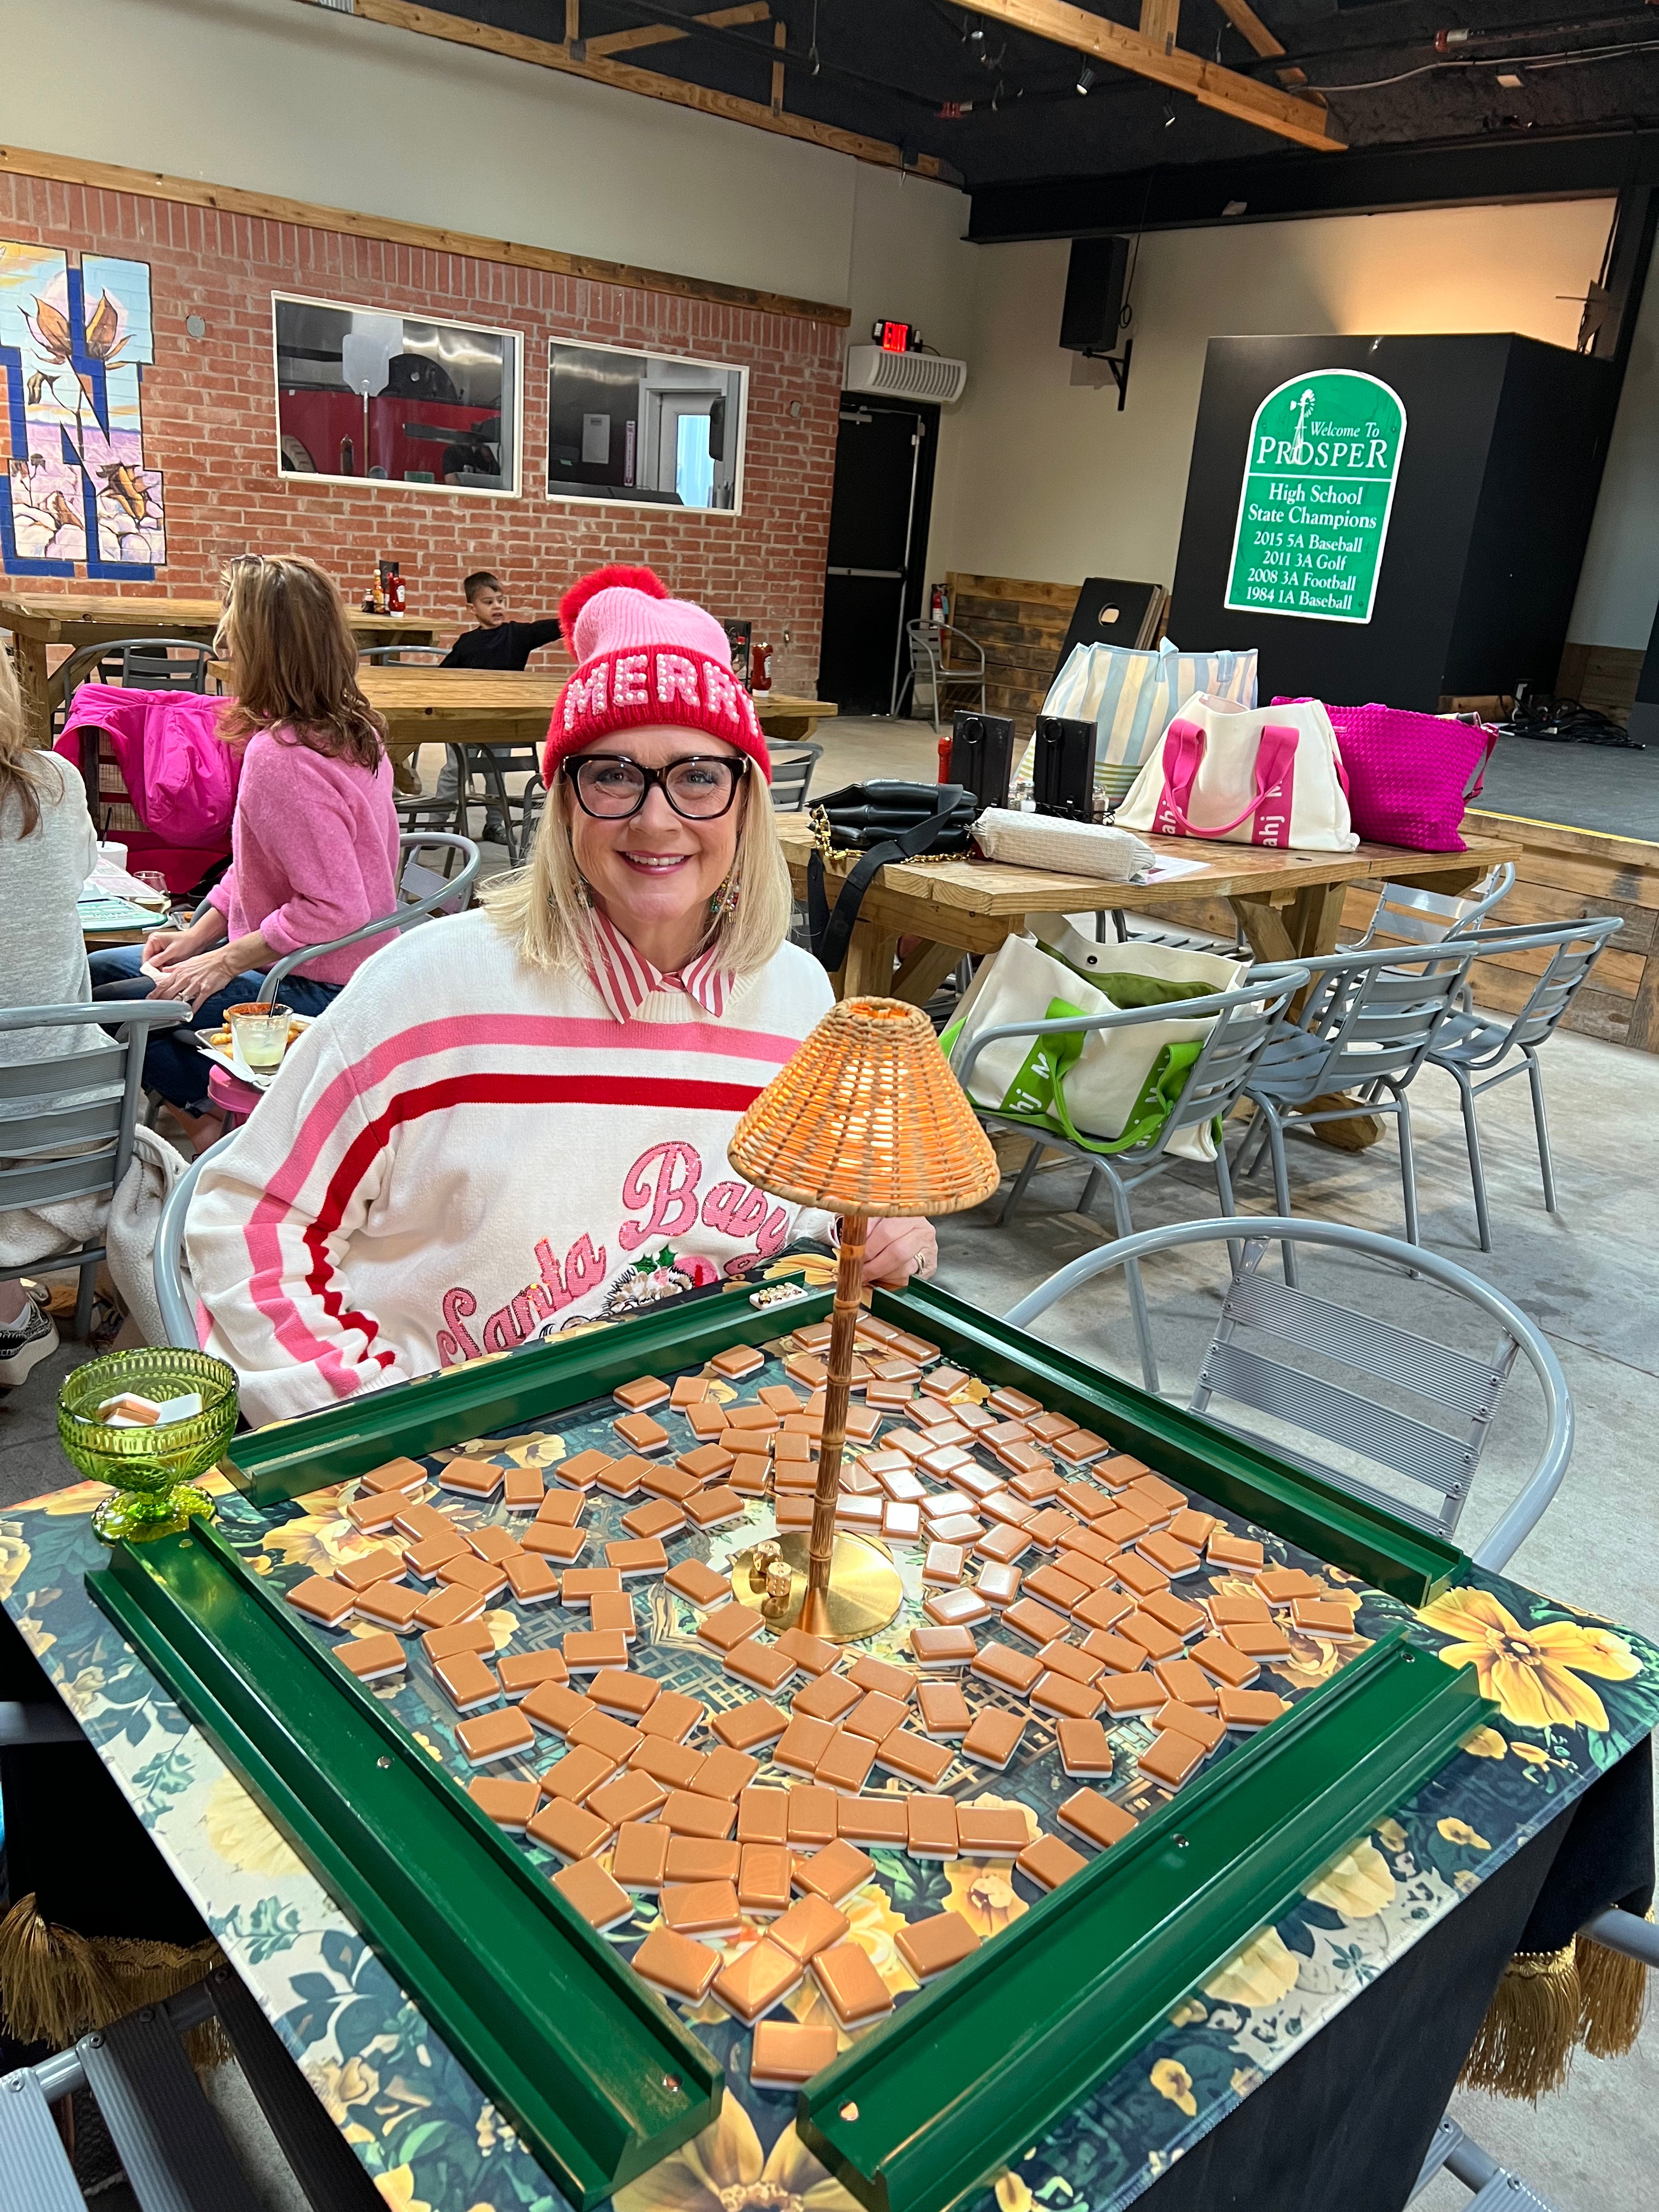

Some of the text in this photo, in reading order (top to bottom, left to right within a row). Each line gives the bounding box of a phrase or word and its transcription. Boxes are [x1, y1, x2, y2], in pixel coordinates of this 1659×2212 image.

[1311, 421, 1380, 438] Welcome To
[1256, 436, 1387, 468] PROSPER
[1268, 482, 1363, 505] High School
[1248, 504, 1377, 530] State Champions
[1254, 531, 1363, 552] 2015 5A Baseball
[1262, 551, 1347, 571] 2011 3A Golf
[1248, 567, 1356, 591] 2008 3A Football
[1246, 586, 1353, 610] 1984 1A Baseball
[564, 653, 759, 737] MERR
[1259, 816, 1285, 847] ahj
[436, 1141, 789, 1368] Santa Baby
